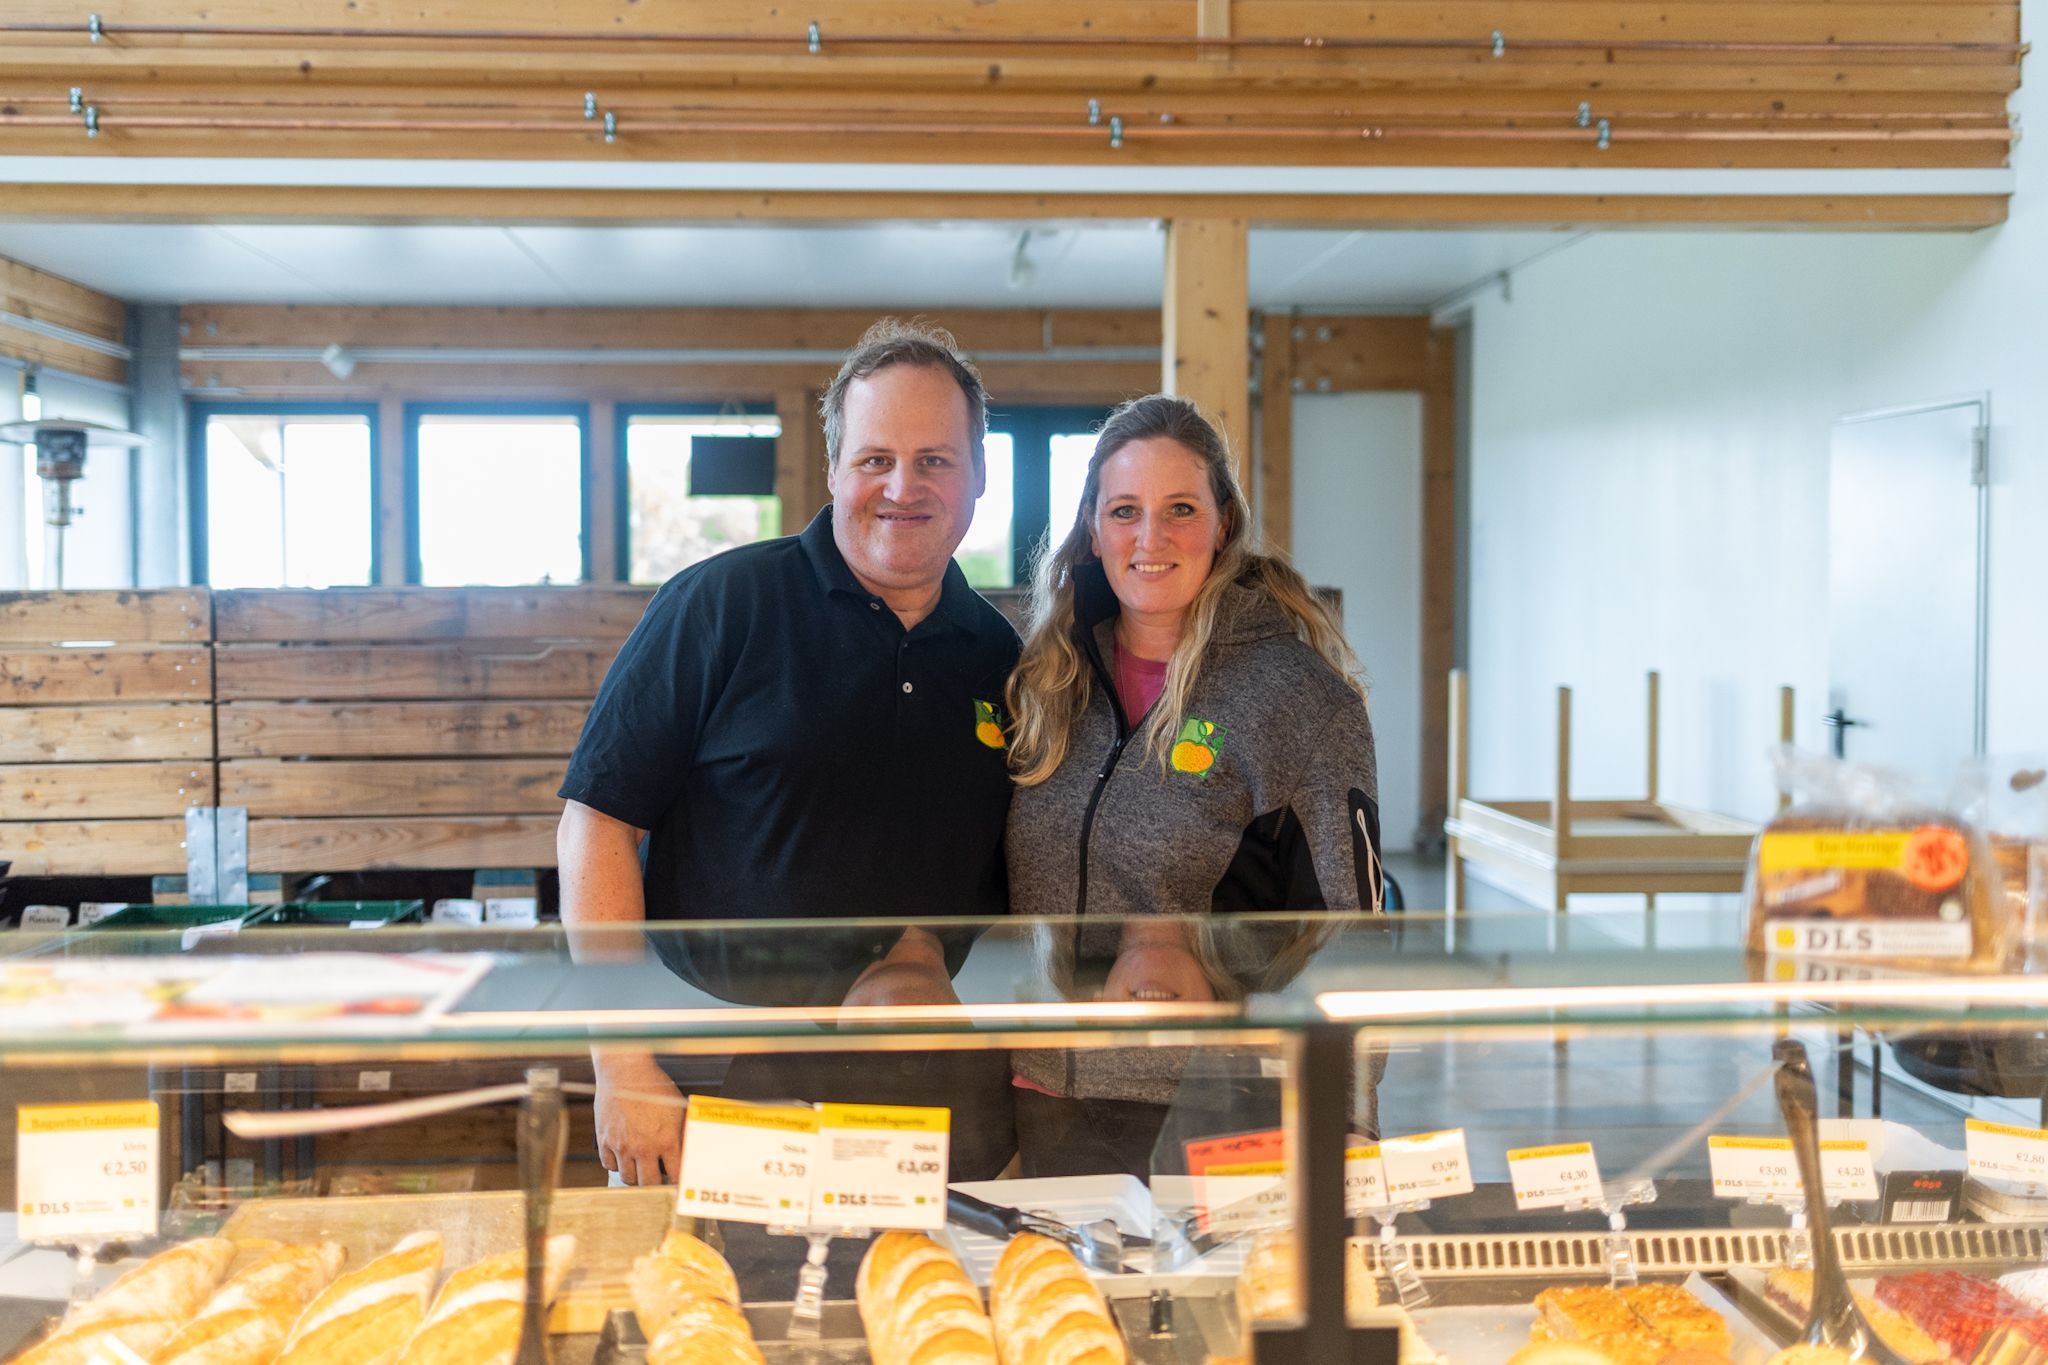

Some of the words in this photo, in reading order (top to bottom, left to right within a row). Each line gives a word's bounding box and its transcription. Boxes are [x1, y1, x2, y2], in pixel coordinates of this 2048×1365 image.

[1807, 928, 1873, 950] DLS
[31, 1118, 81, 1130] Baguette
[83, 1114, 146, 1127] Traditional
[2016, 1152, 2045, 1165] €2,80
[764, 1160, 806, 1177] €3,70
[1979, 1160, 1998, 1169] DLS
[1560, 1170, 1588, 1181] €4,30
[1759, 1166, 1787, 1177] €3,90
[1838, 1167, 1865, 1177] €4,20
[1398, 1181, 1416, 1191] DLS
[1724, 1179, 1743, 1187] DLS
[700, 1190, 729, 1203] DLS
[1526, 1190, 1545, 1198] DLS
[838, 1194, 867, 1206] DLS
[39, 1202, 70, 1214] DLS
